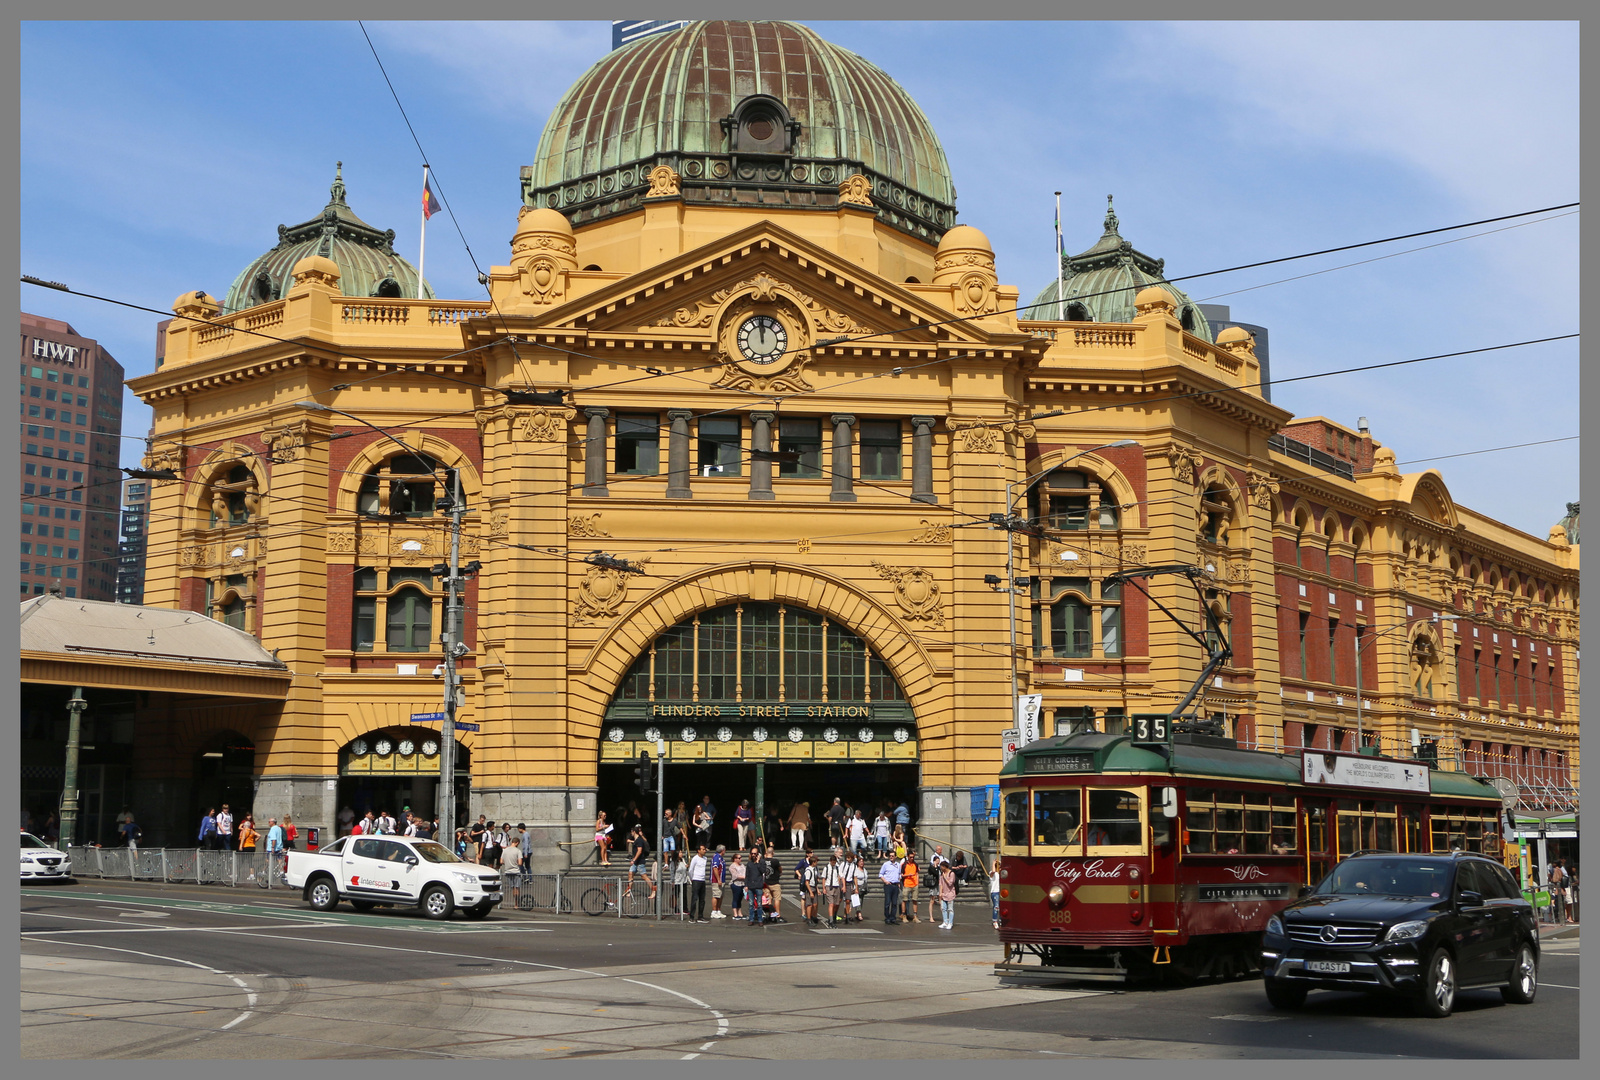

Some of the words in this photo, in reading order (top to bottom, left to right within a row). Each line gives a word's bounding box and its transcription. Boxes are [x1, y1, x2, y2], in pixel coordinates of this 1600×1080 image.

[33, 338, 79, 362] HWT
[653, 705, 721, 717] FLINDERS
[739, 705, 791, 717] STREET
[807, 706, 869, 718] STATION
[1052, 859, 1081, 883] City
[1082, 859, 1125, 878] Circle
[1050, 910, 1071, 924] 888
